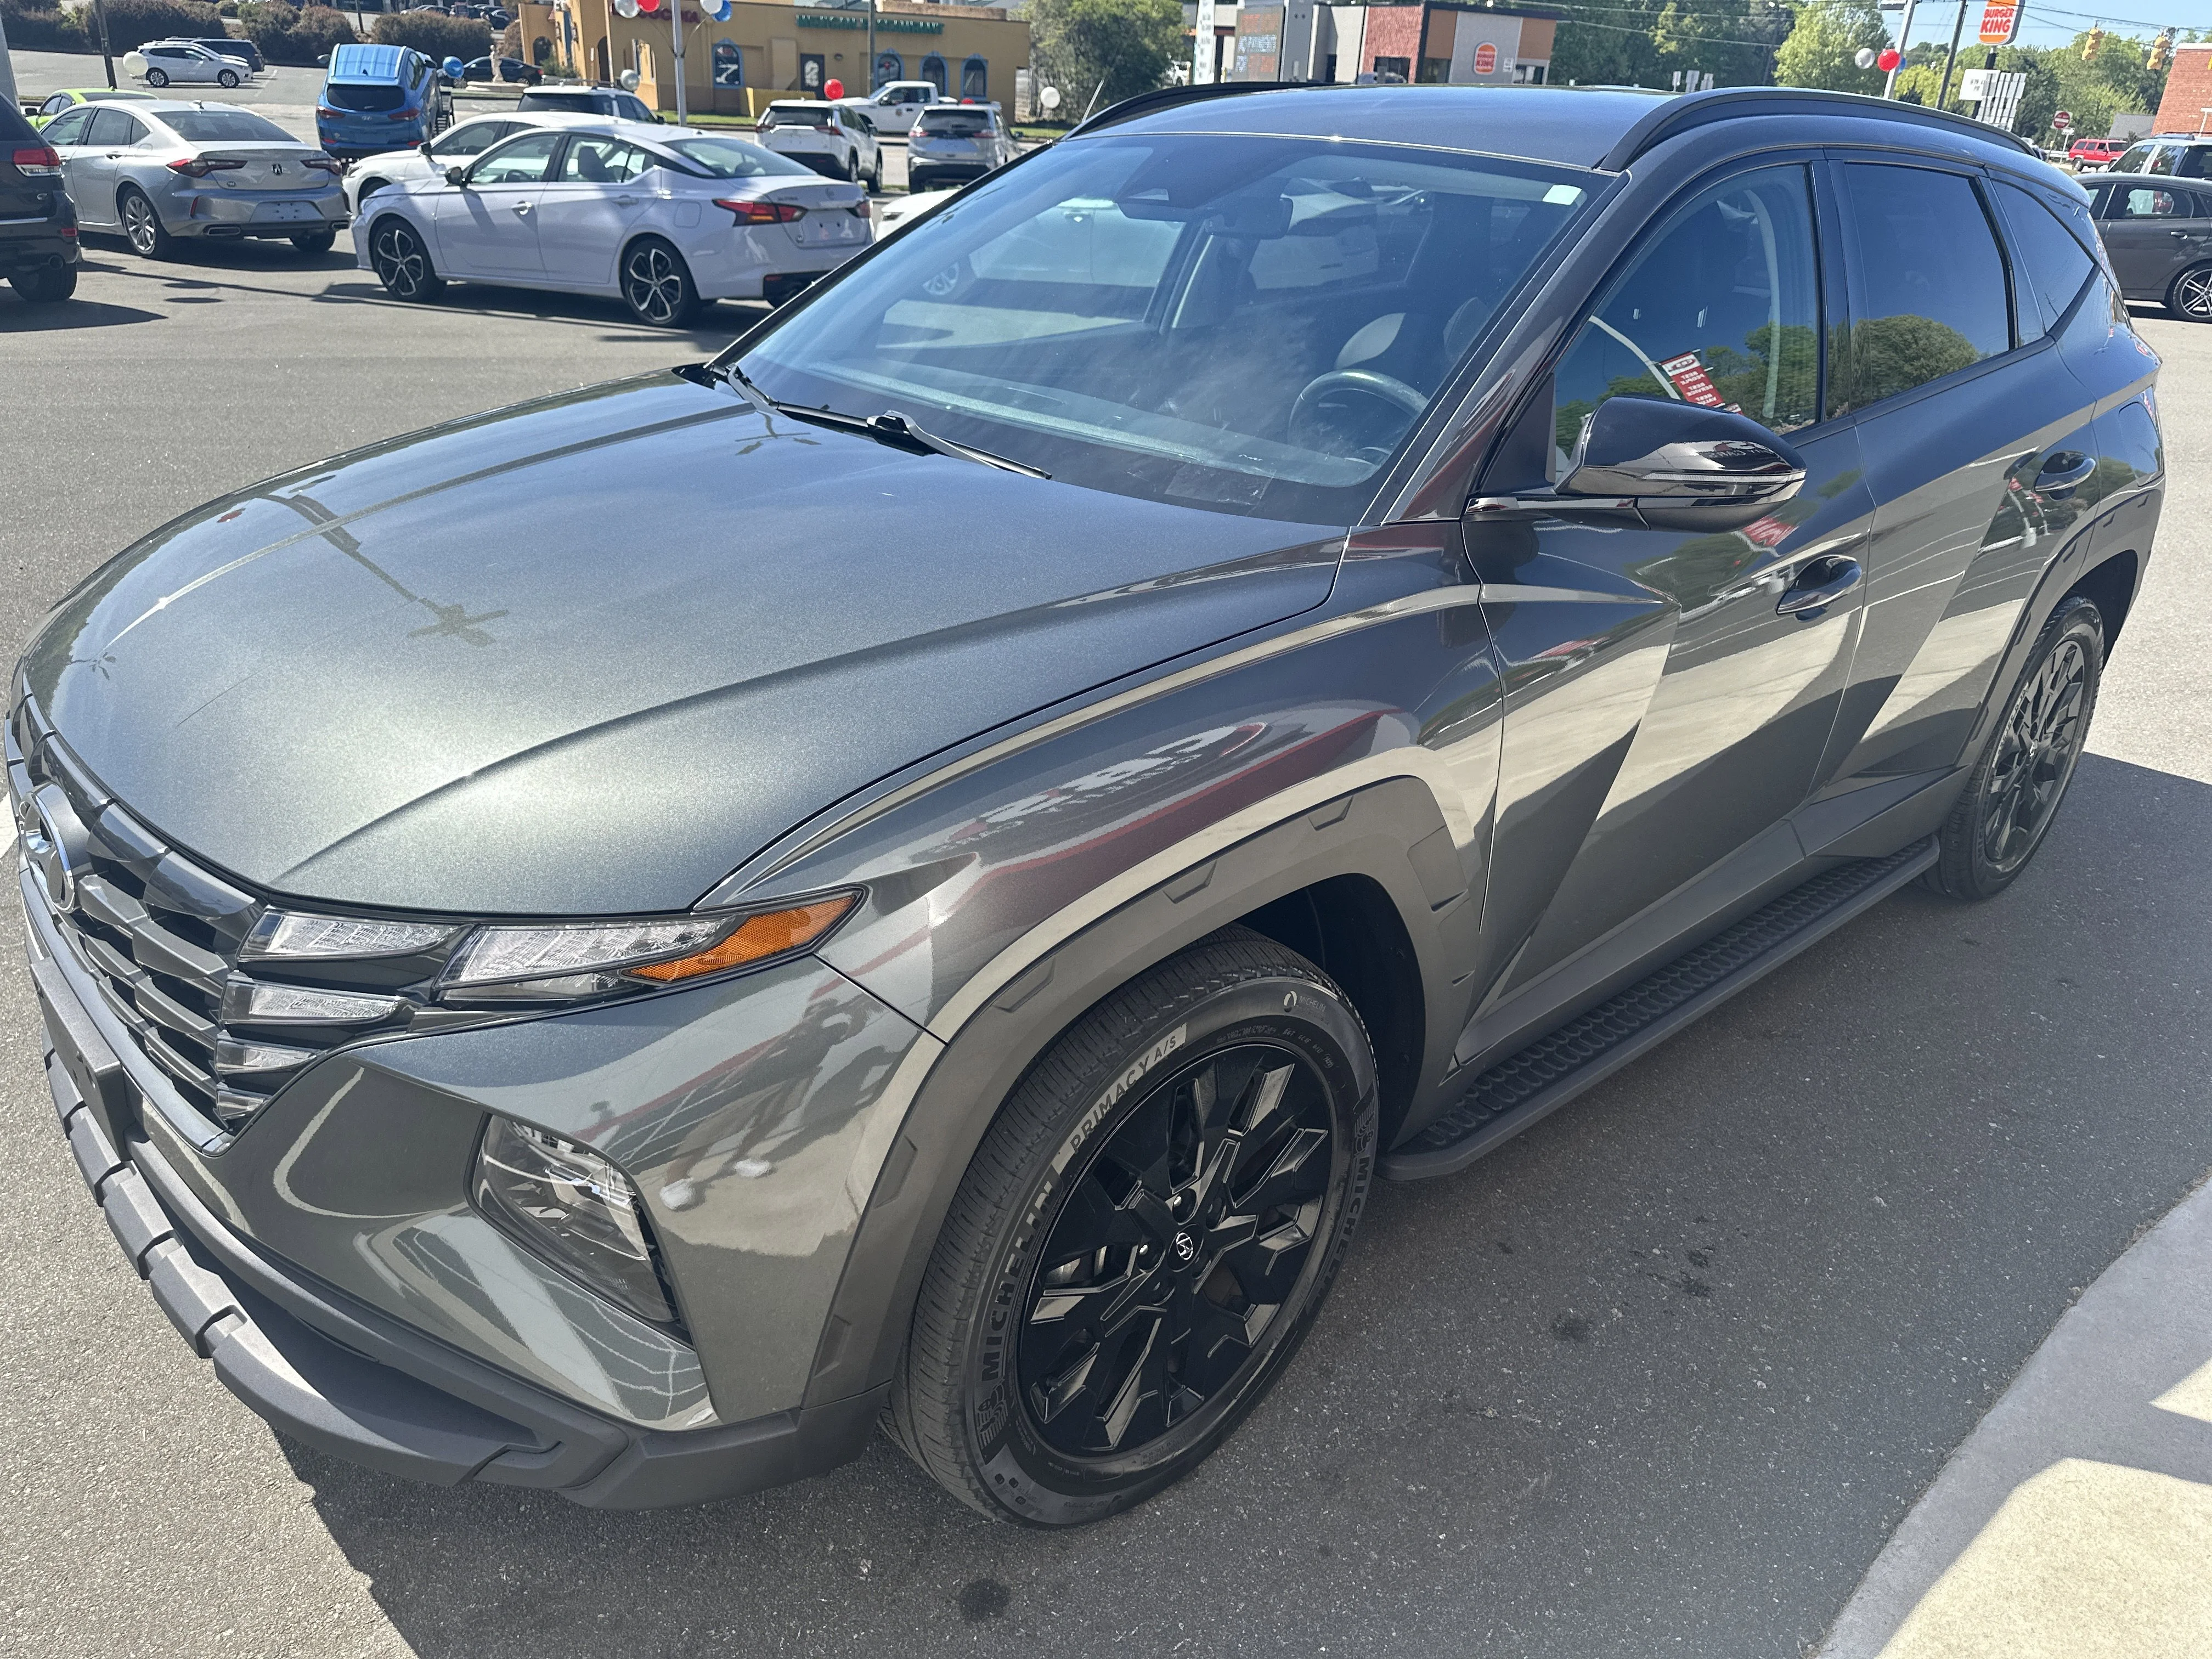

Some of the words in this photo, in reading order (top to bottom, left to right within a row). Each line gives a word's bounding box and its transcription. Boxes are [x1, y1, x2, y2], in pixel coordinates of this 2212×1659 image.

[1984, 8, 2015, 18] BURGER
[1980, 19, 2011, 33] KING
[1299, 996, 1327, 1012] MICHELIN
[1070, 1055, 1150, 1153] PRIMACY
[1154, 1035, 1177, 1062] A/S
[981, 1180, 1058, 1382] MICHELIN
